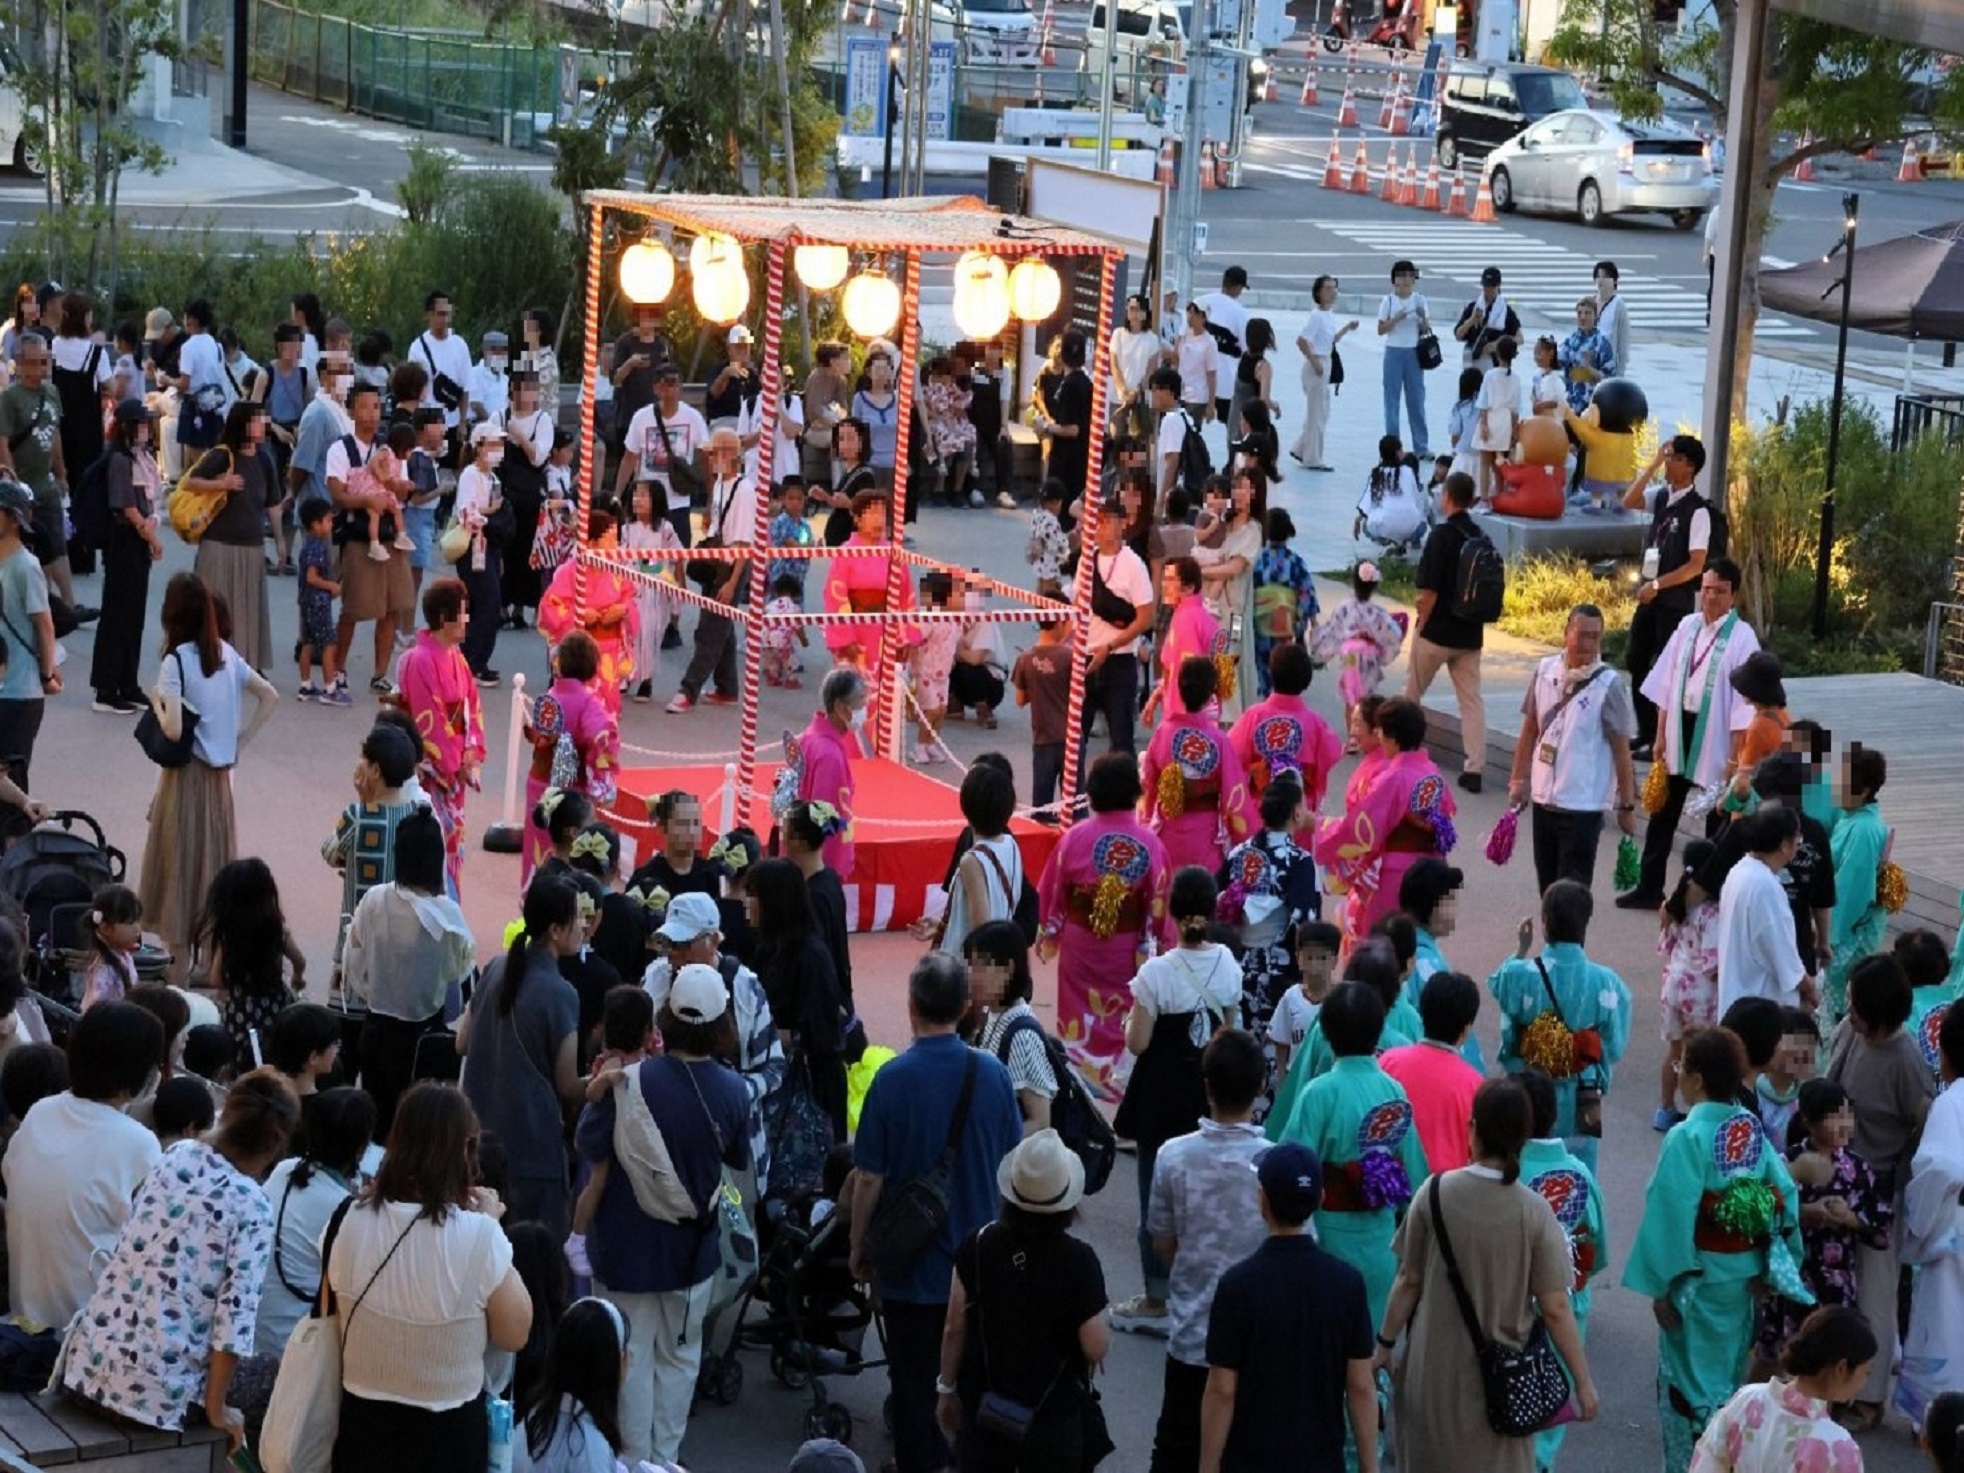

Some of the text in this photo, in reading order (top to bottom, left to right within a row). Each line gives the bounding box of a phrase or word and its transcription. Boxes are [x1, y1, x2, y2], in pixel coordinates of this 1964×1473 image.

[1181, 734, 1208, 761] 祭
[1266, 721, 1290, 749] 祭
[1107, 840, 1137, 869] 祭
[1367, 1104, 1403, 1140] 祭
[1725, 1119, 1752, 1162] 祭
